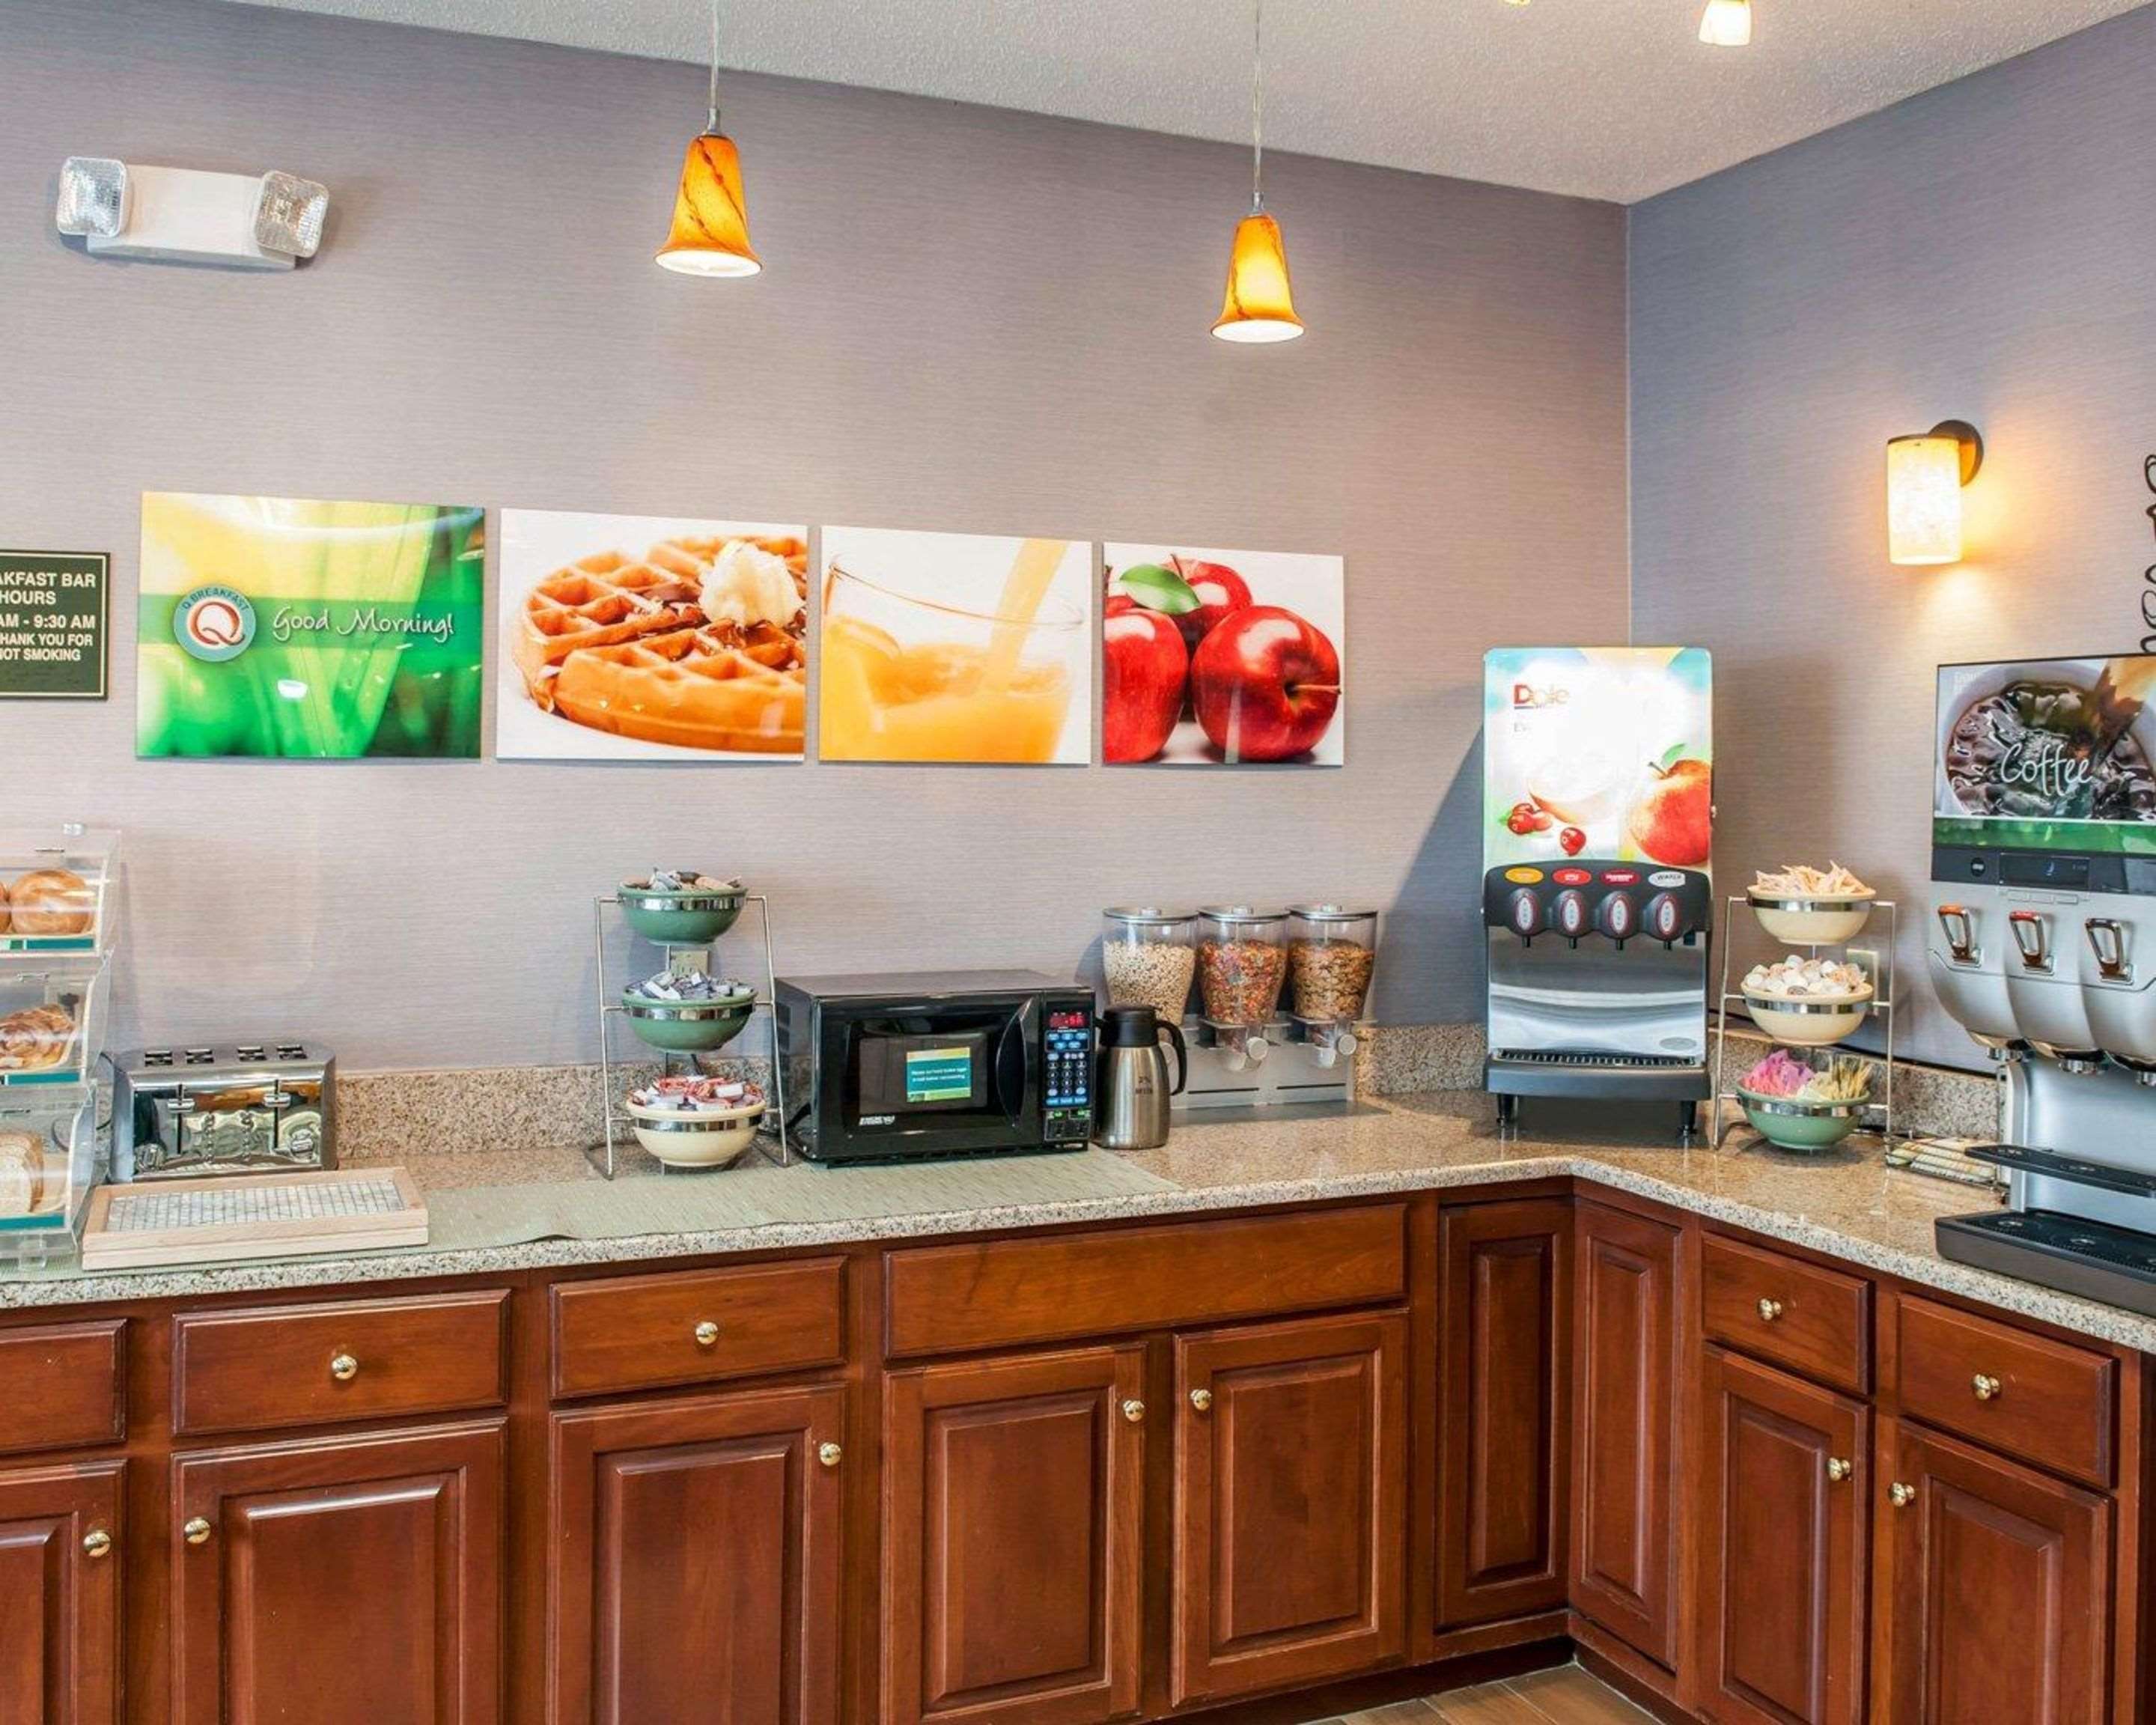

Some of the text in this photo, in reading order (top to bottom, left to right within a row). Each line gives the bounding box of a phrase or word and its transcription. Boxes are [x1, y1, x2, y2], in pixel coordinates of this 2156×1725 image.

[61, 573, 97, 588] BAR
[0, 590, 57, 605] HOURS
[190, 587, 249, 611] BREAKFAST
[34, 614, 67, 629] 9:30
[70, 614, 96, 629] AM
[190, 601, 246, 646] Q
[272, 605, 455, 643] Good Morning!
[37, 633, 64, 646] YOU
[67, 634, 94, 647] FOR
[23, 648, 81, 661] SMOKING
[2000, 743, 2093, 797] Coffee
